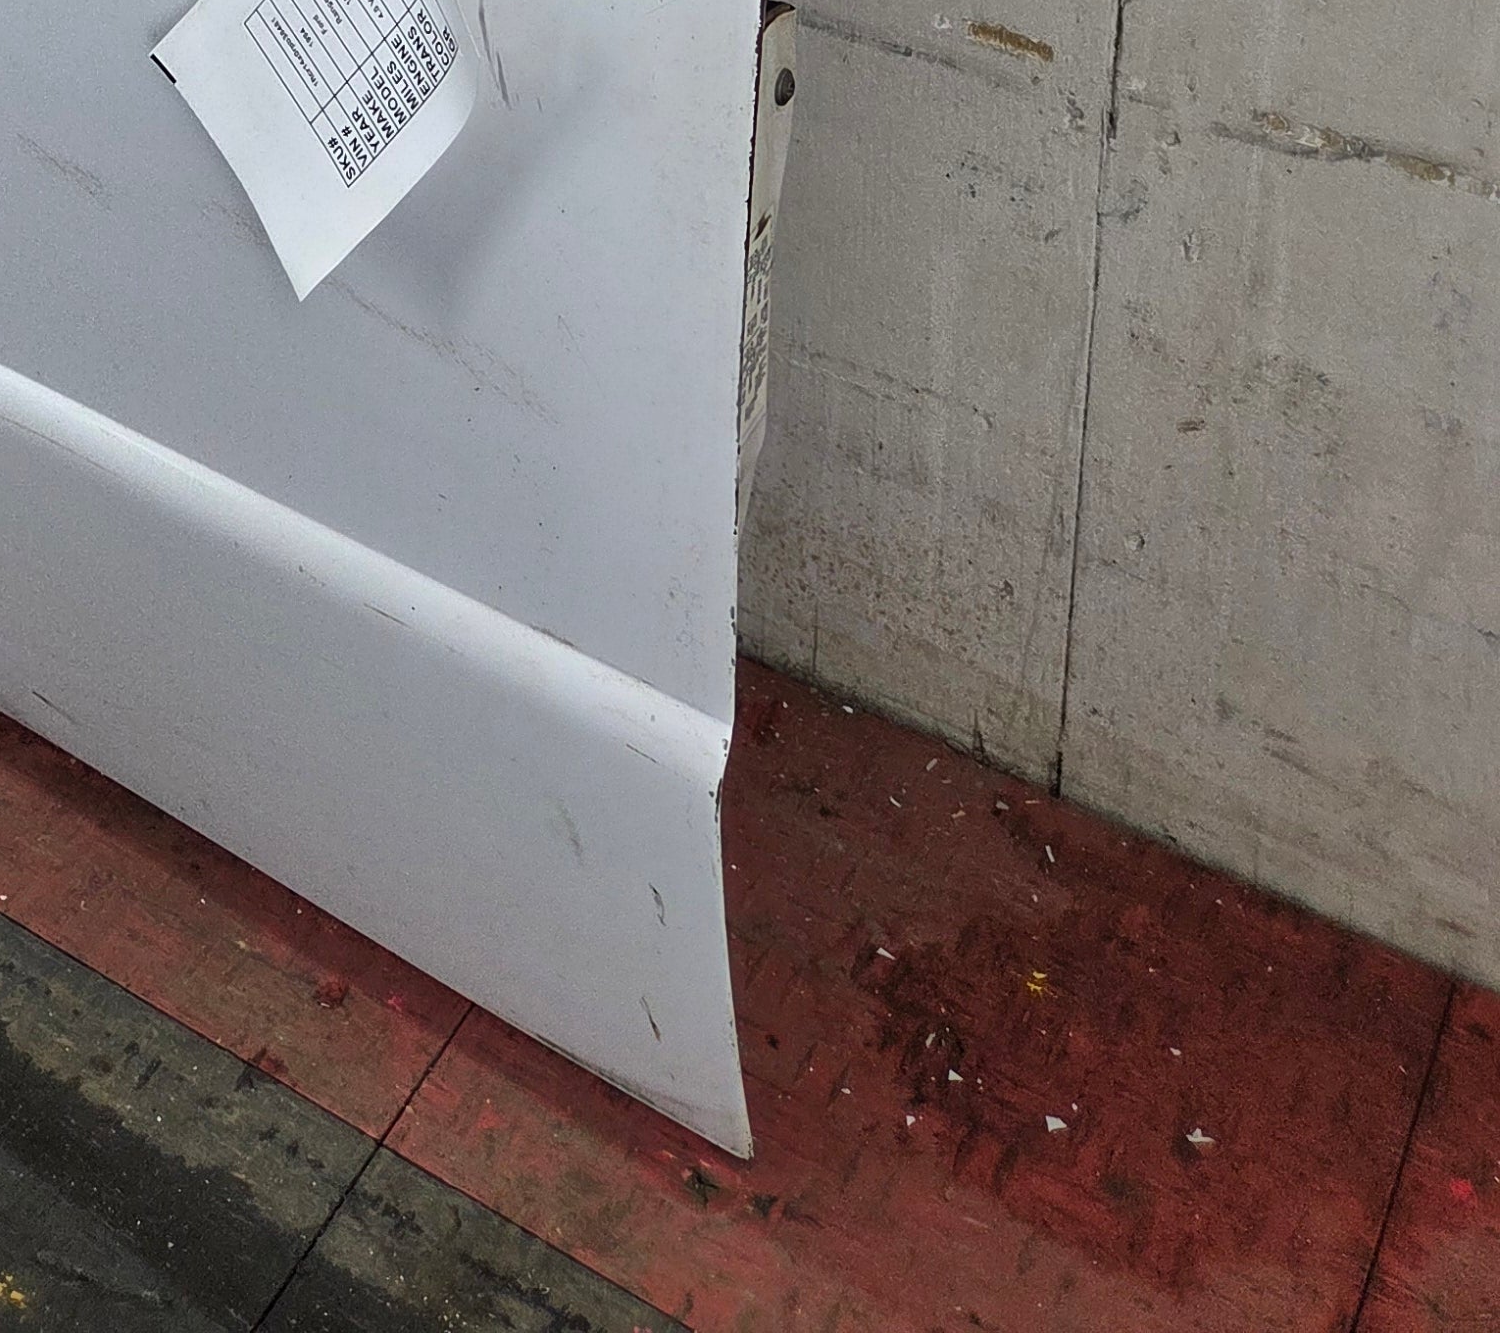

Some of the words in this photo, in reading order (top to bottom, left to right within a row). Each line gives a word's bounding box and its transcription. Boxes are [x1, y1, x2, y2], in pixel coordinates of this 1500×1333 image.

[299, 27, 313, 48] 1994
[312, 14, 328, 36] Ford
[416, 8, 450, 67] COLOR
[442, 25, 458, 53] GR
[390, 33, 431, 97] ENGINE
[407, 25, 440, 83] TRANS
[370, 65, 407, 125] MODEL
[386, 60, 420, 111] MILES
[351, 106, 380, 154] YEAR
[361, 89, 395, 139] MAKE
[327, 136, 356, 181] SKU#
[348, 136, 368, 168] VIN
